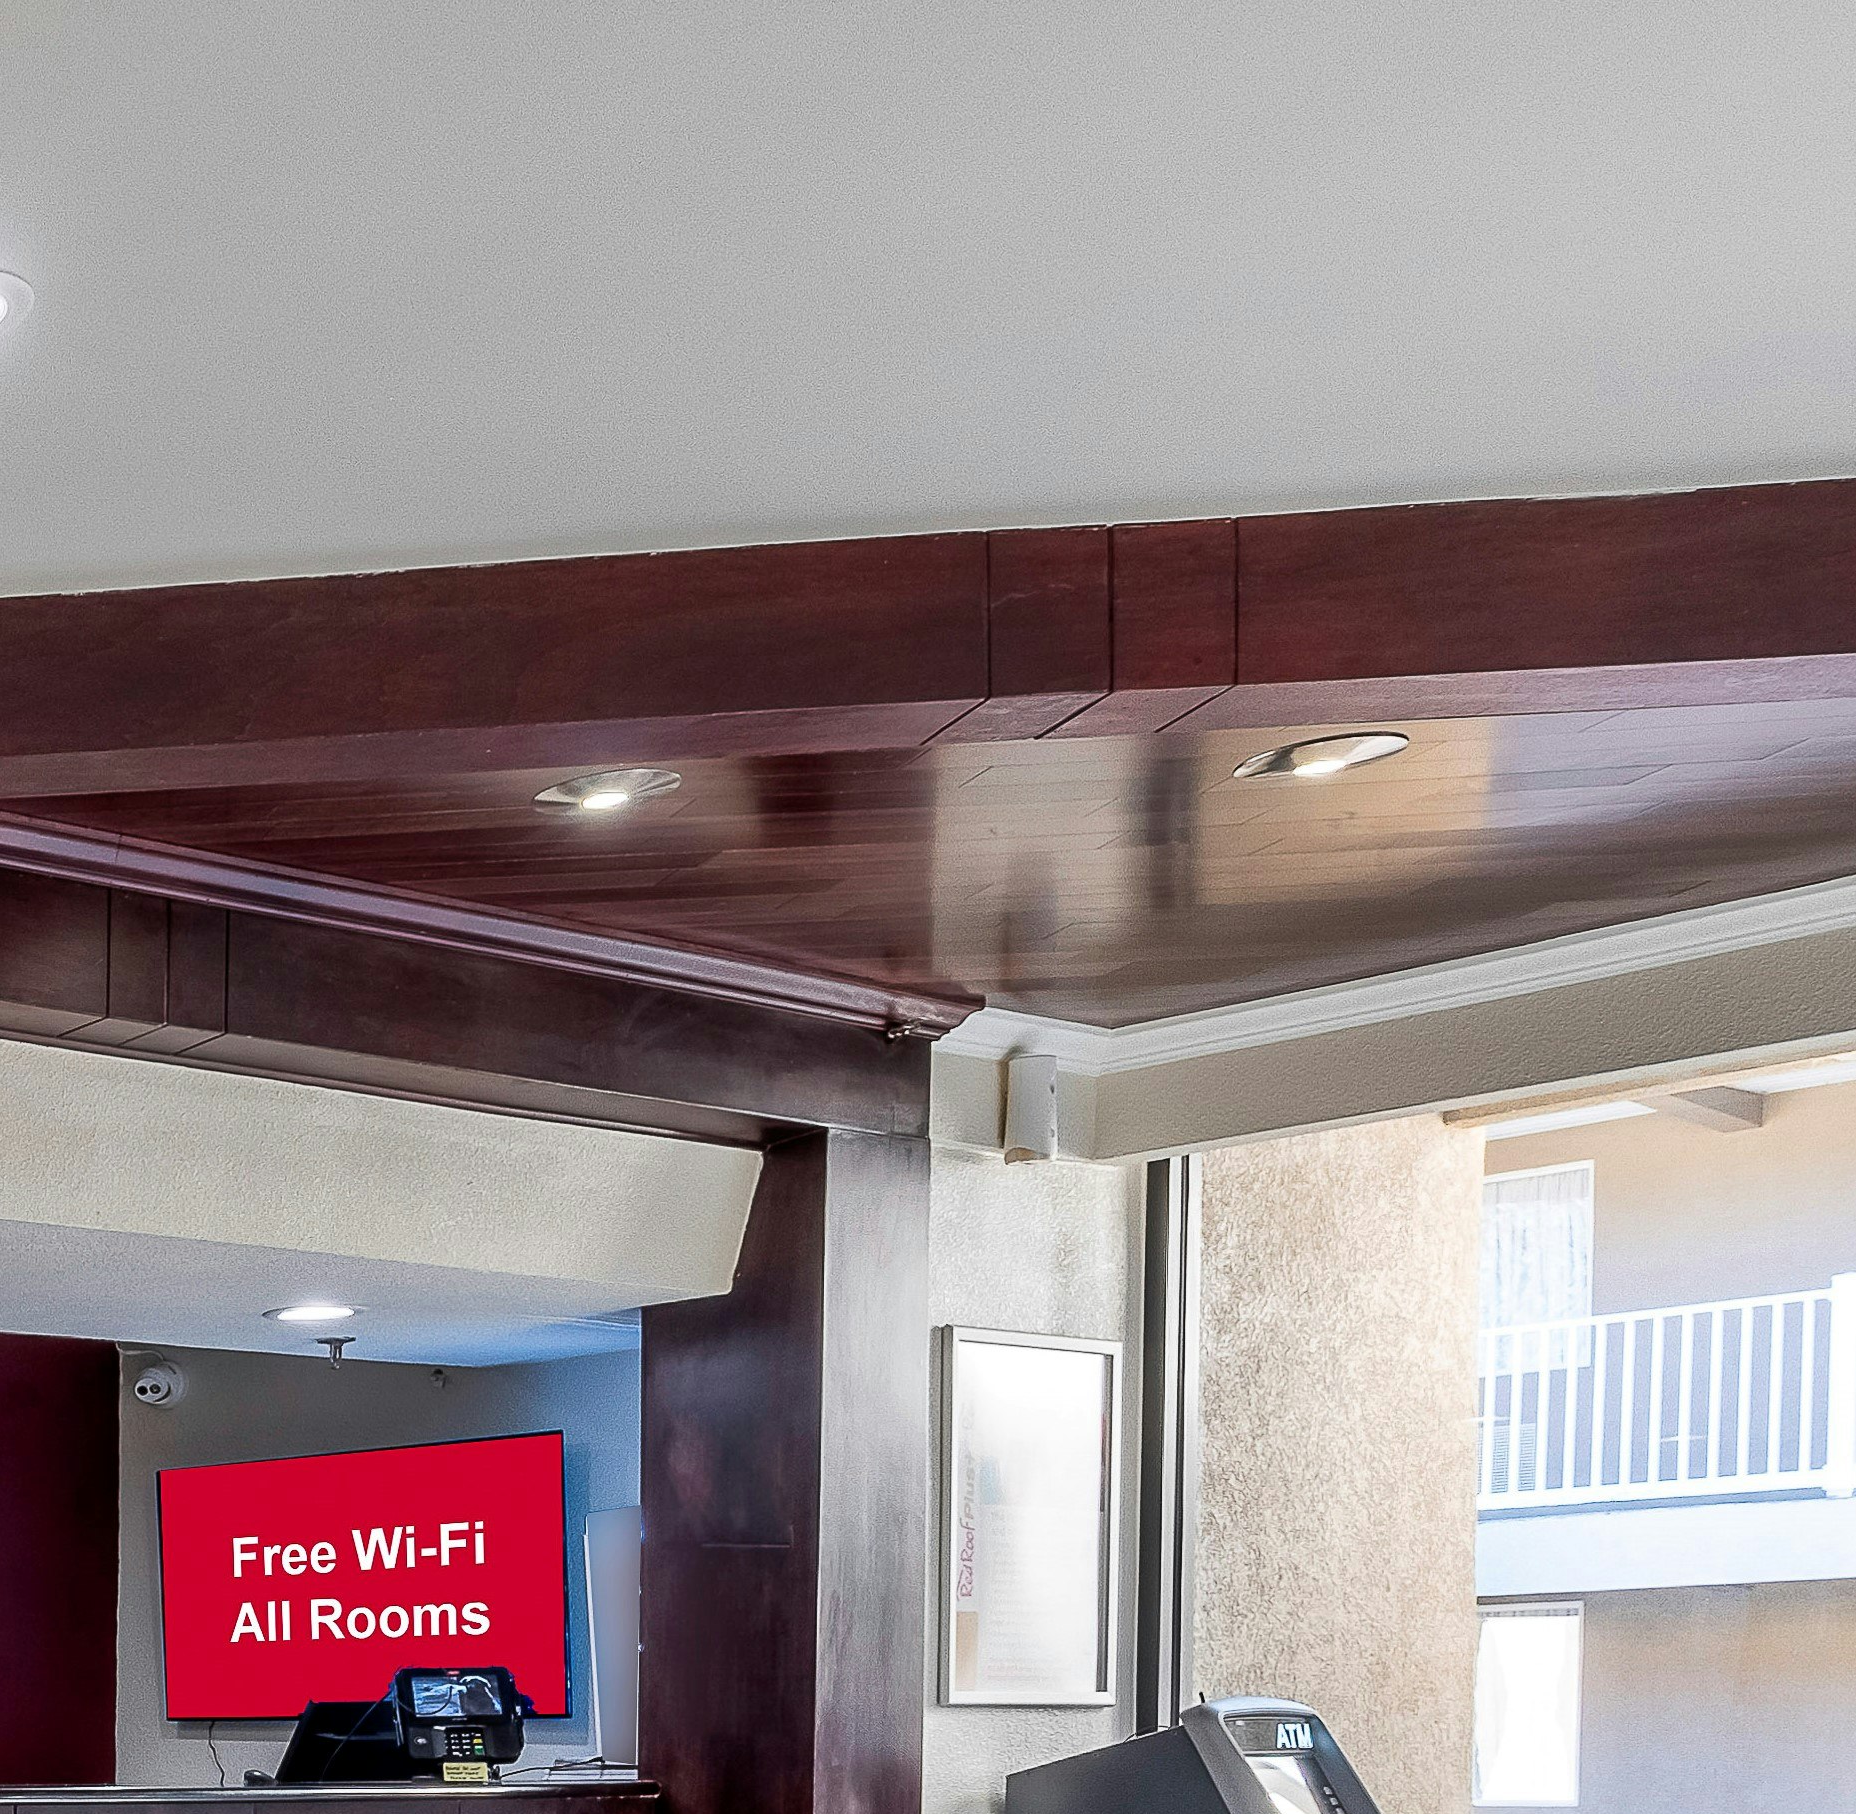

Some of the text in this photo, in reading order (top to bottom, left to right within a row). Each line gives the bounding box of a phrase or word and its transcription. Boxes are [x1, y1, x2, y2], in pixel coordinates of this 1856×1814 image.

[231, 1520, 486, 1579] Free Wi-Fi
[229, 1597, 491, 1643] All Rooms
[1276, 1723, 1313, 1749] ATM
